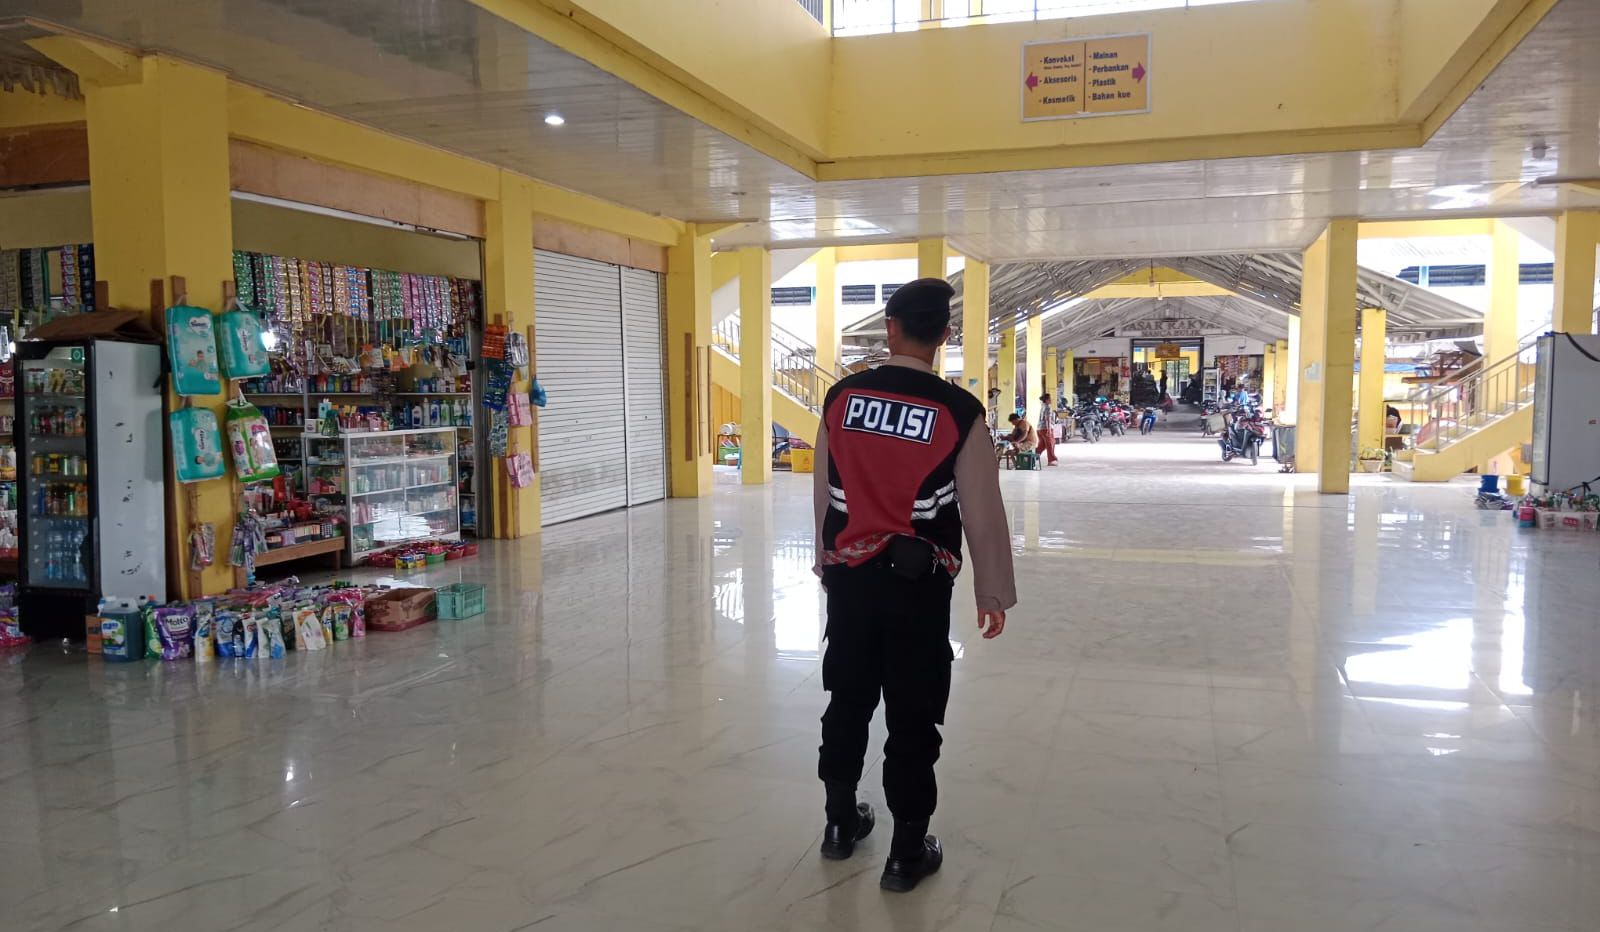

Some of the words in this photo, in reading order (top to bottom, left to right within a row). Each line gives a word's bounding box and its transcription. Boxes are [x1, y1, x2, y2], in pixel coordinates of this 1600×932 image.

[1043, 54, 1075, 64] Konveksi
[1092, 51, 1118, 60] Mainan
[1092, 63, 1129, 73] Perbankan
[1043, 74, 1077, 84] Aksesoris
[1092, 78, 1117, 87] Plastik
[1043, 94, 1076, 104] Kosmetik
[1092, 91, 1115, 101] Bahan
[1117, 90, 1131, 99] kue
[1168, 319, 1221, 330] RAKYA
[846, 397, 935, 440] POLISI
[165, 616, 189, 626] Molto
